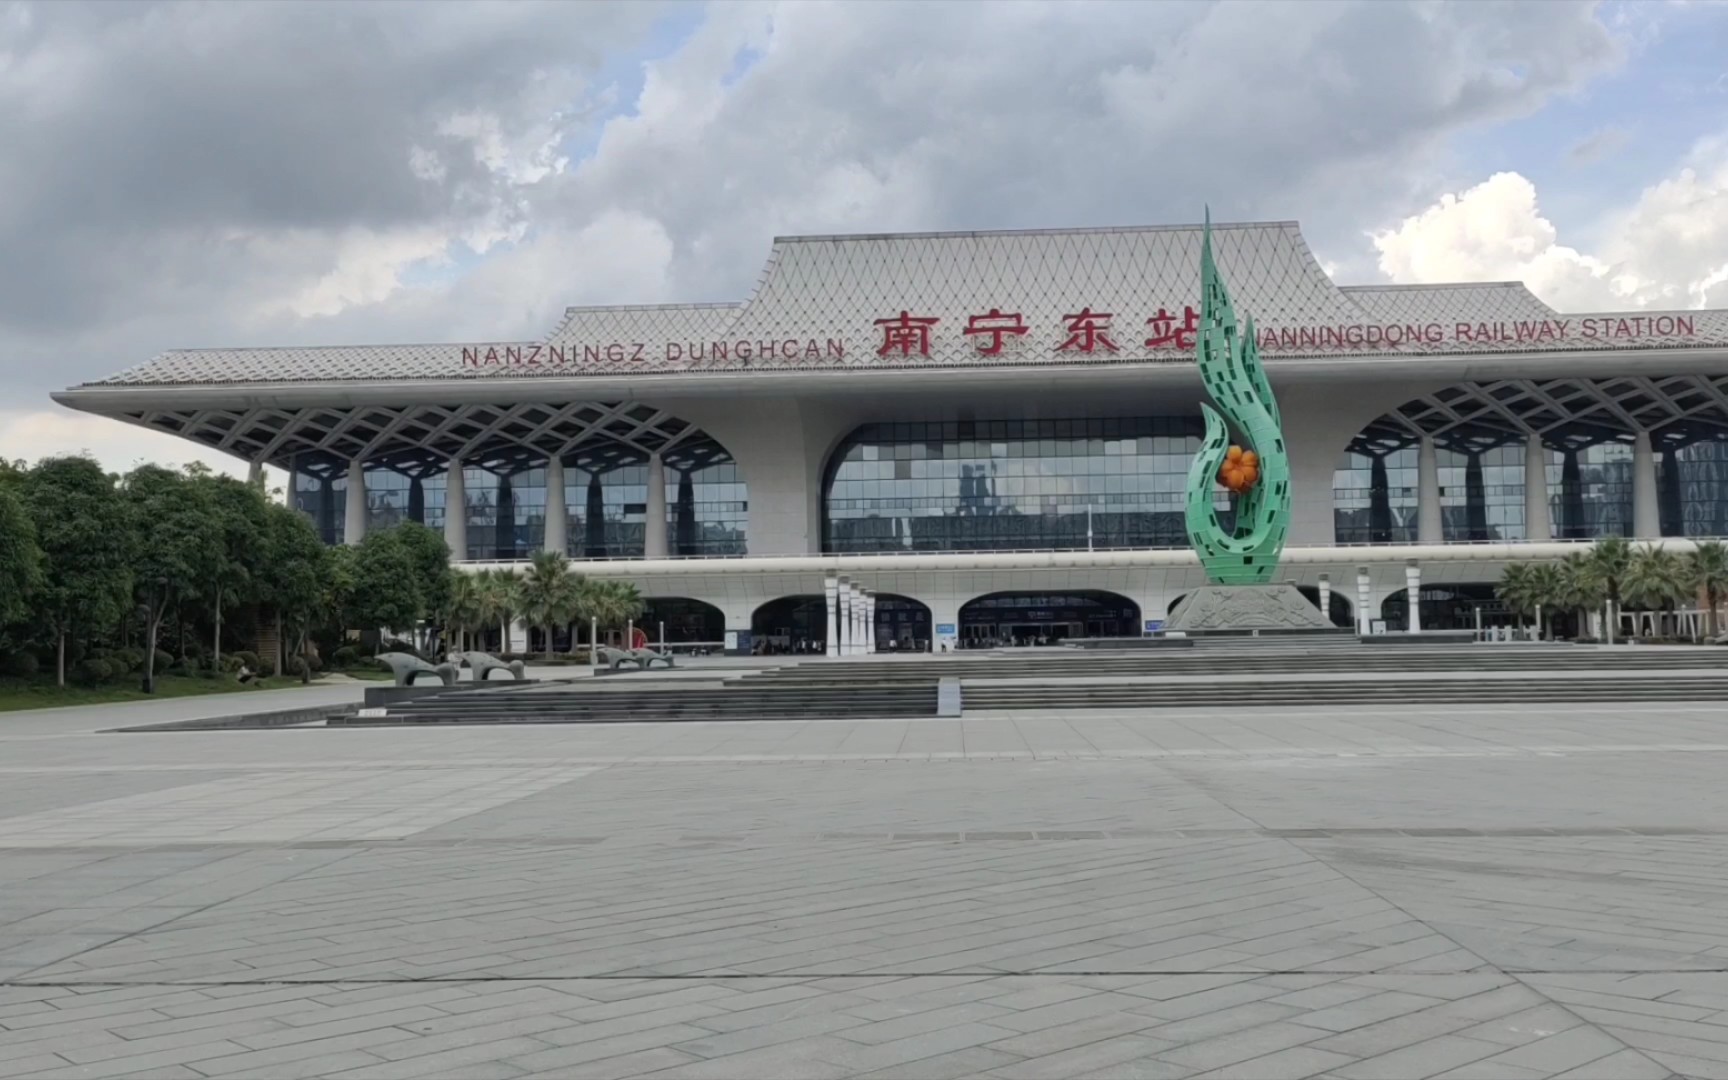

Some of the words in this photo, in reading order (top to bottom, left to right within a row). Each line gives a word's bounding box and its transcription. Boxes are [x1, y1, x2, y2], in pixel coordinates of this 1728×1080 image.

[873, 305, 1200, 359] 南宁东站
[1456, 319, 1571, 342] RAILWAY
[1581, 315, 1695, 339] STATION
[462, 343, 645, 367] NANZNINGZ
[666, 338, 845, 363] DUNGHCAN
